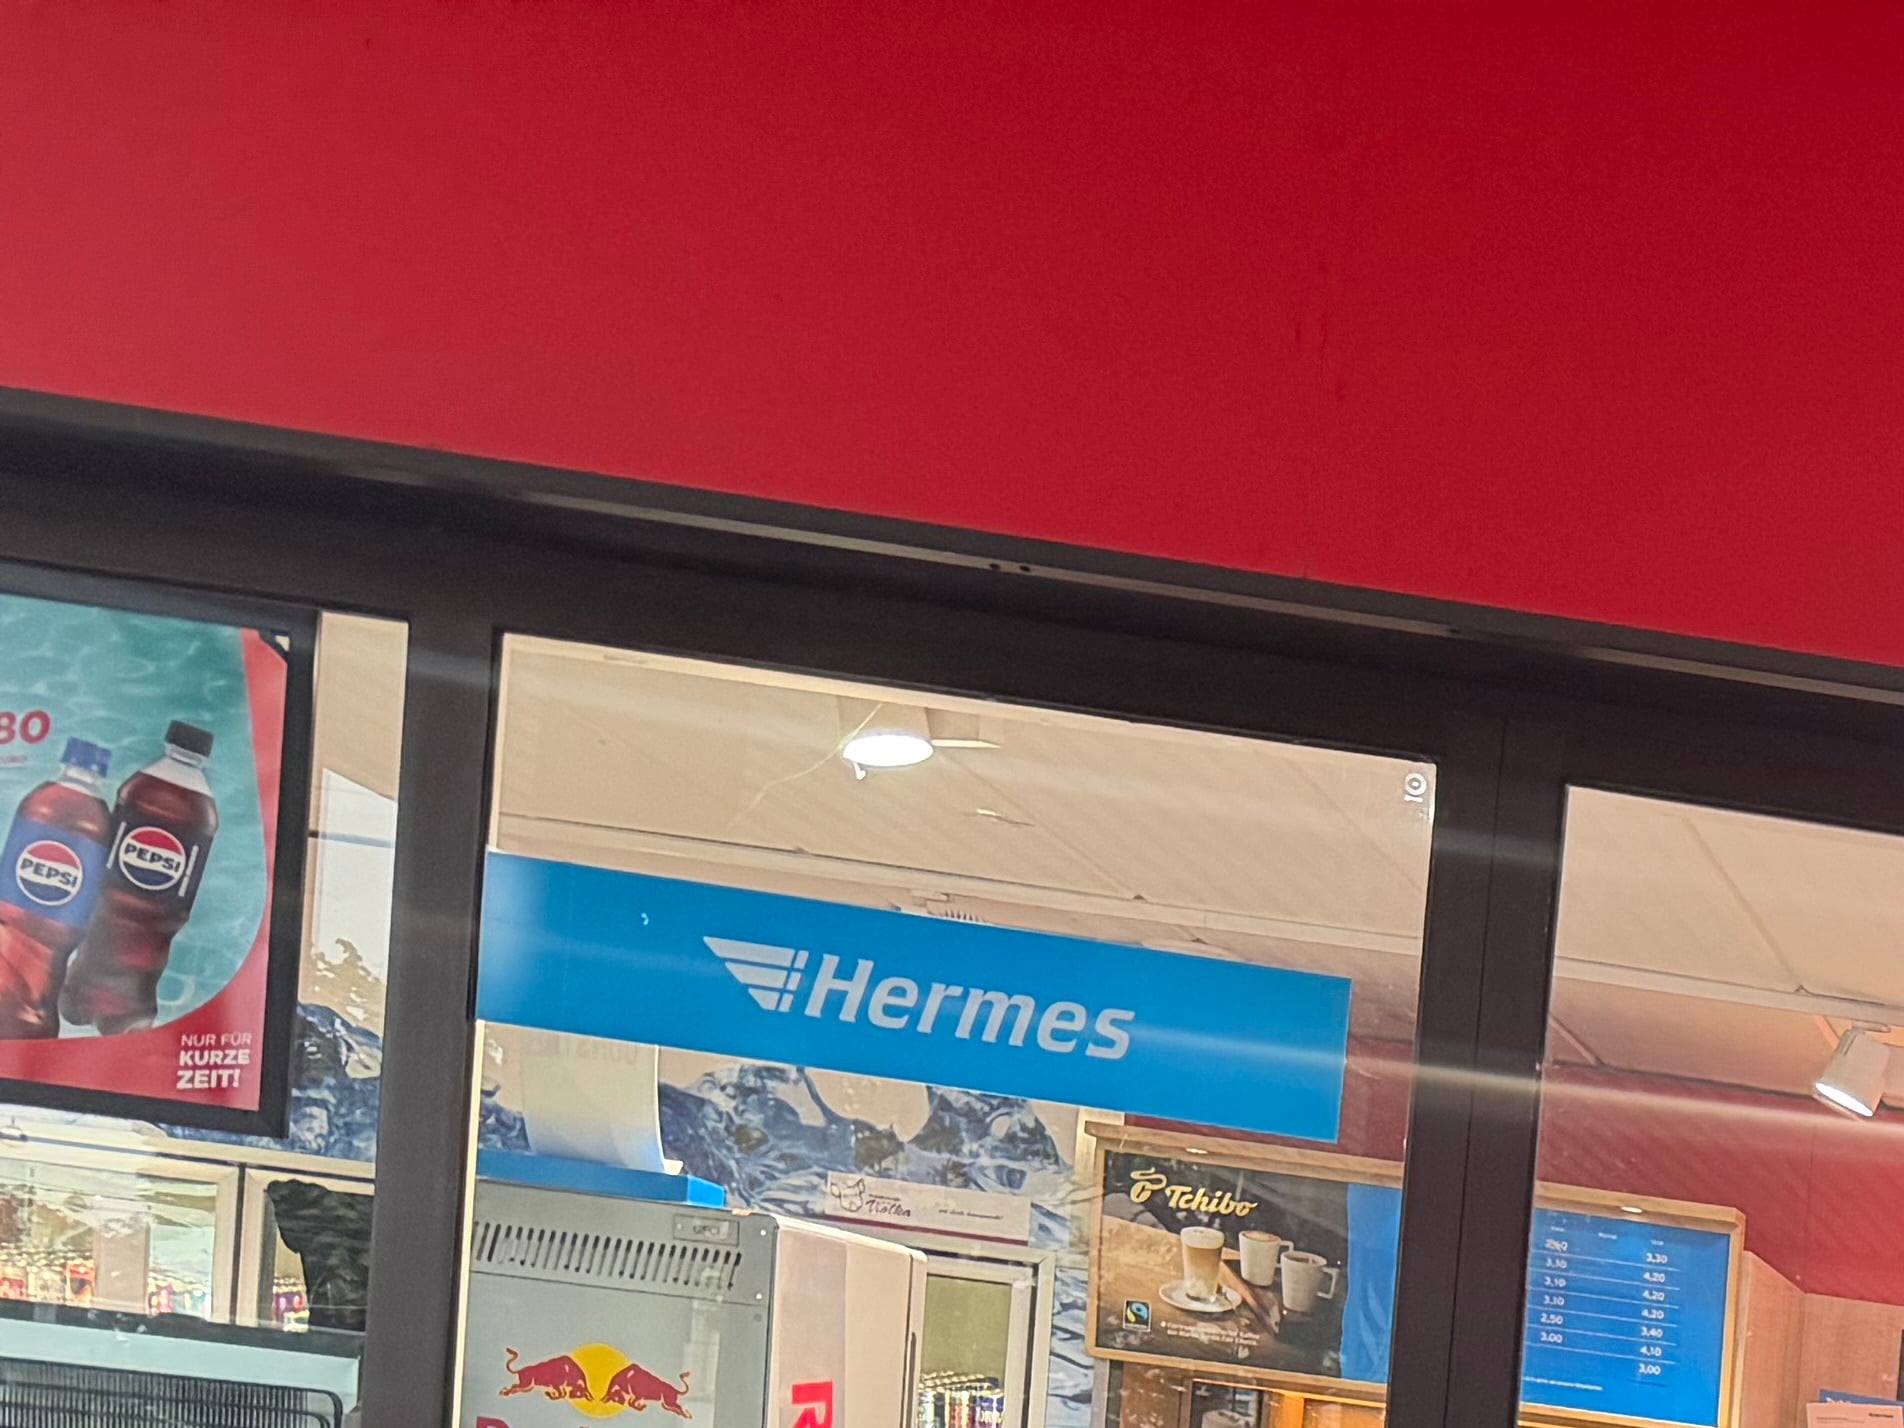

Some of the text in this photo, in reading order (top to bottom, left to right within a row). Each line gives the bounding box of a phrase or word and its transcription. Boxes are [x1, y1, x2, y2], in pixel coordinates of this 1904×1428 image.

[124, 842, 182, 873] PEPSI
[19, 858, 78, 887] PEPSI
[803, 953, 1136, 1060] Hermes
[181, 1031, 253, 1047] NUR FÜR
[179, 1049, 251, 1067] KURZE
[176, 1068, 241, 1090] ZEIT!
[1165, 1184, 1258, 1217] Tchibo
